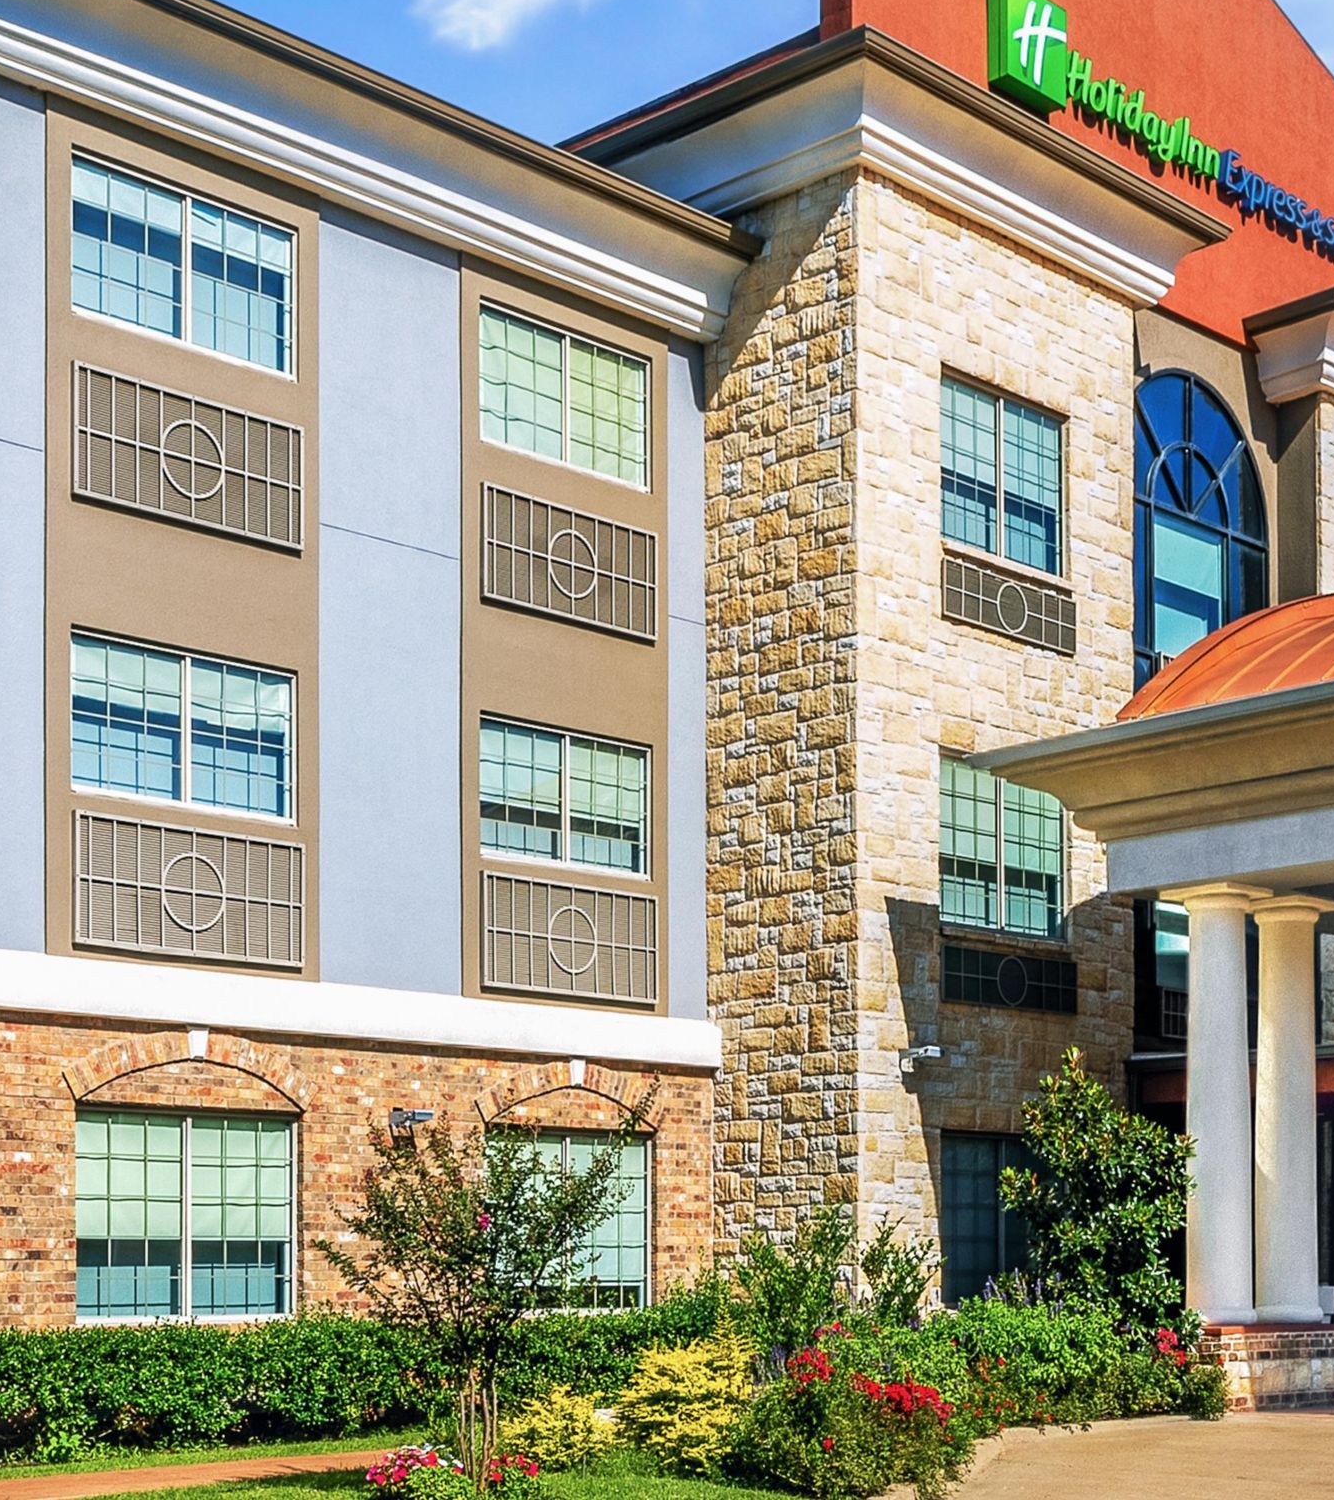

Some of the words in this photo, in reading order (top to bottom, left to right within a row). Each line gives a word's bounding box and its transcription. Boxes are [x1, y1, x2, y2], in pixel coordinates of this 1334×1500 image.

[1067, 50, 1176, 162] Holiday
[1178, 116, 1221, 179] Inn
[1223, 149, 1308, 229] Express
[1310, 208, 1325, 242] &
